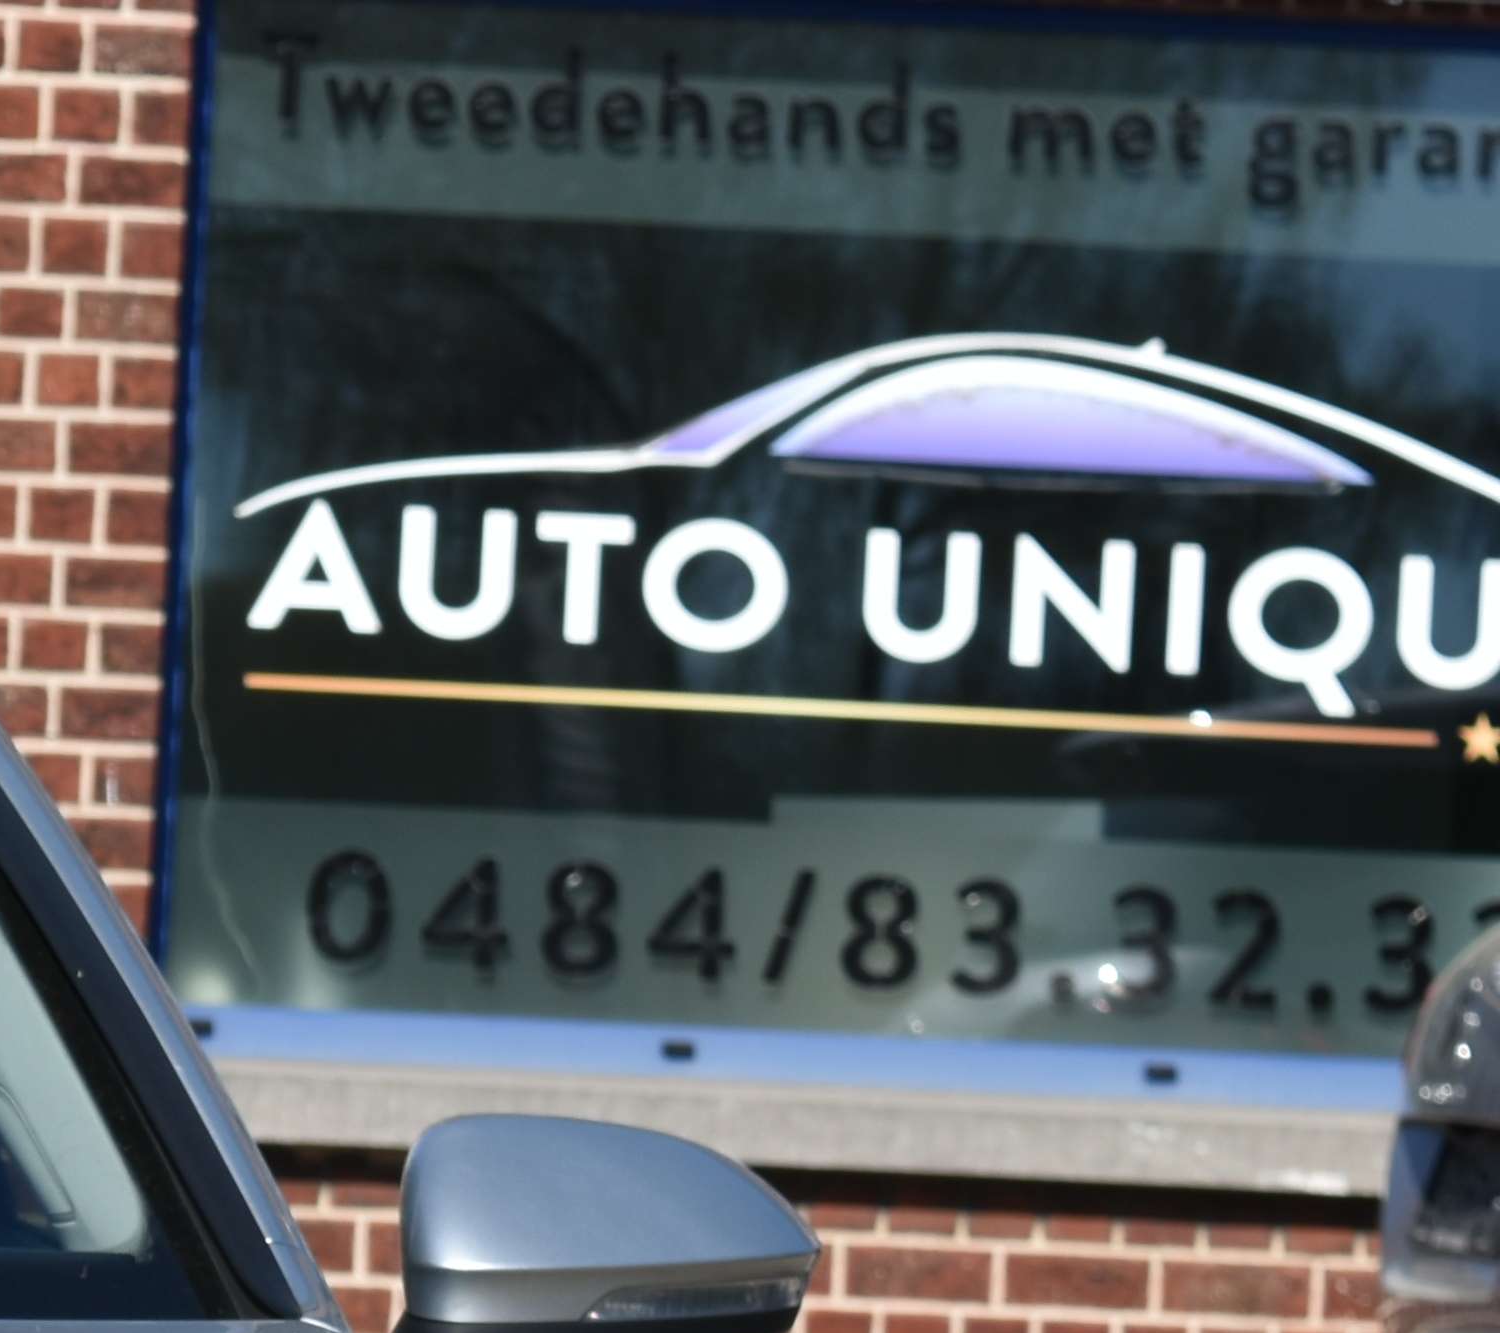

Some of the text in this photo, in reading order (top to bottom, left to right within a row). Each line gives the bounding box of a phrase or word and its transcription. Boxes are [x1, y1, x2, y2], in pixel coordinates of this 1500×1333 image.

[263, 30, 960, 164] Tweedehands
[1009, 100, 1206, 172] met
[246, 499, 1500, 718] AUTO UNIQU
[306, 848, 1500, 1014] 0484/83.32.3
